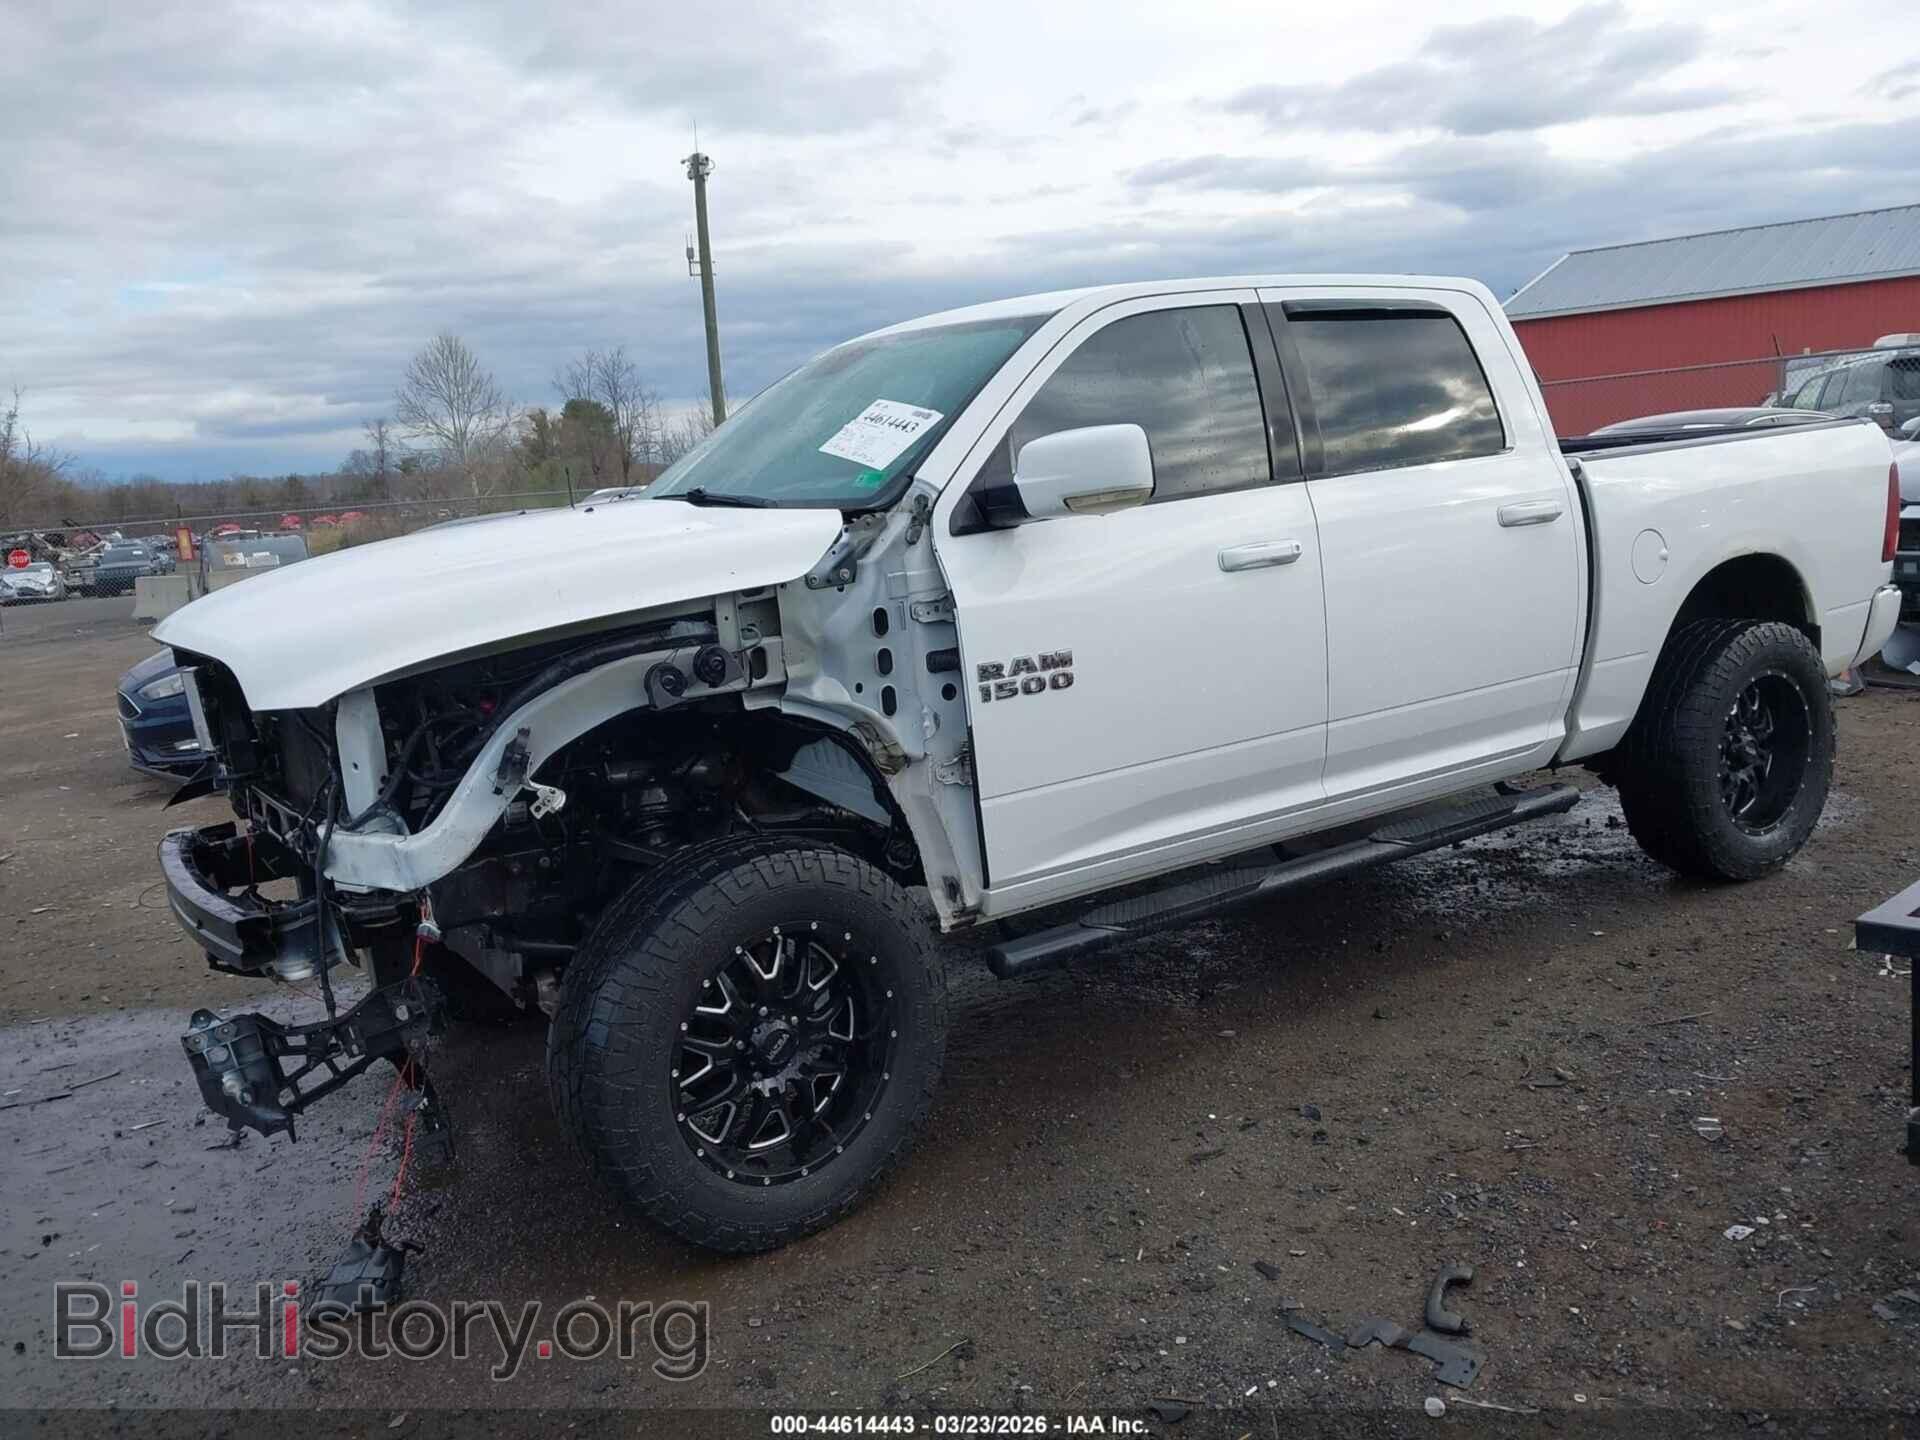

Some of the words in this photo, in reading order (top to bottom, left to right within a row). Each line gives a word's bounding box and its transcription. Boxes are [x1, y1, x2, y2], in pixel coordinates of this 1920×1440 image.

[10, 555, 28, 564] STOP
[977, 649, 1073, 683] RAM
[978, 670, 1074, 703] 1500
